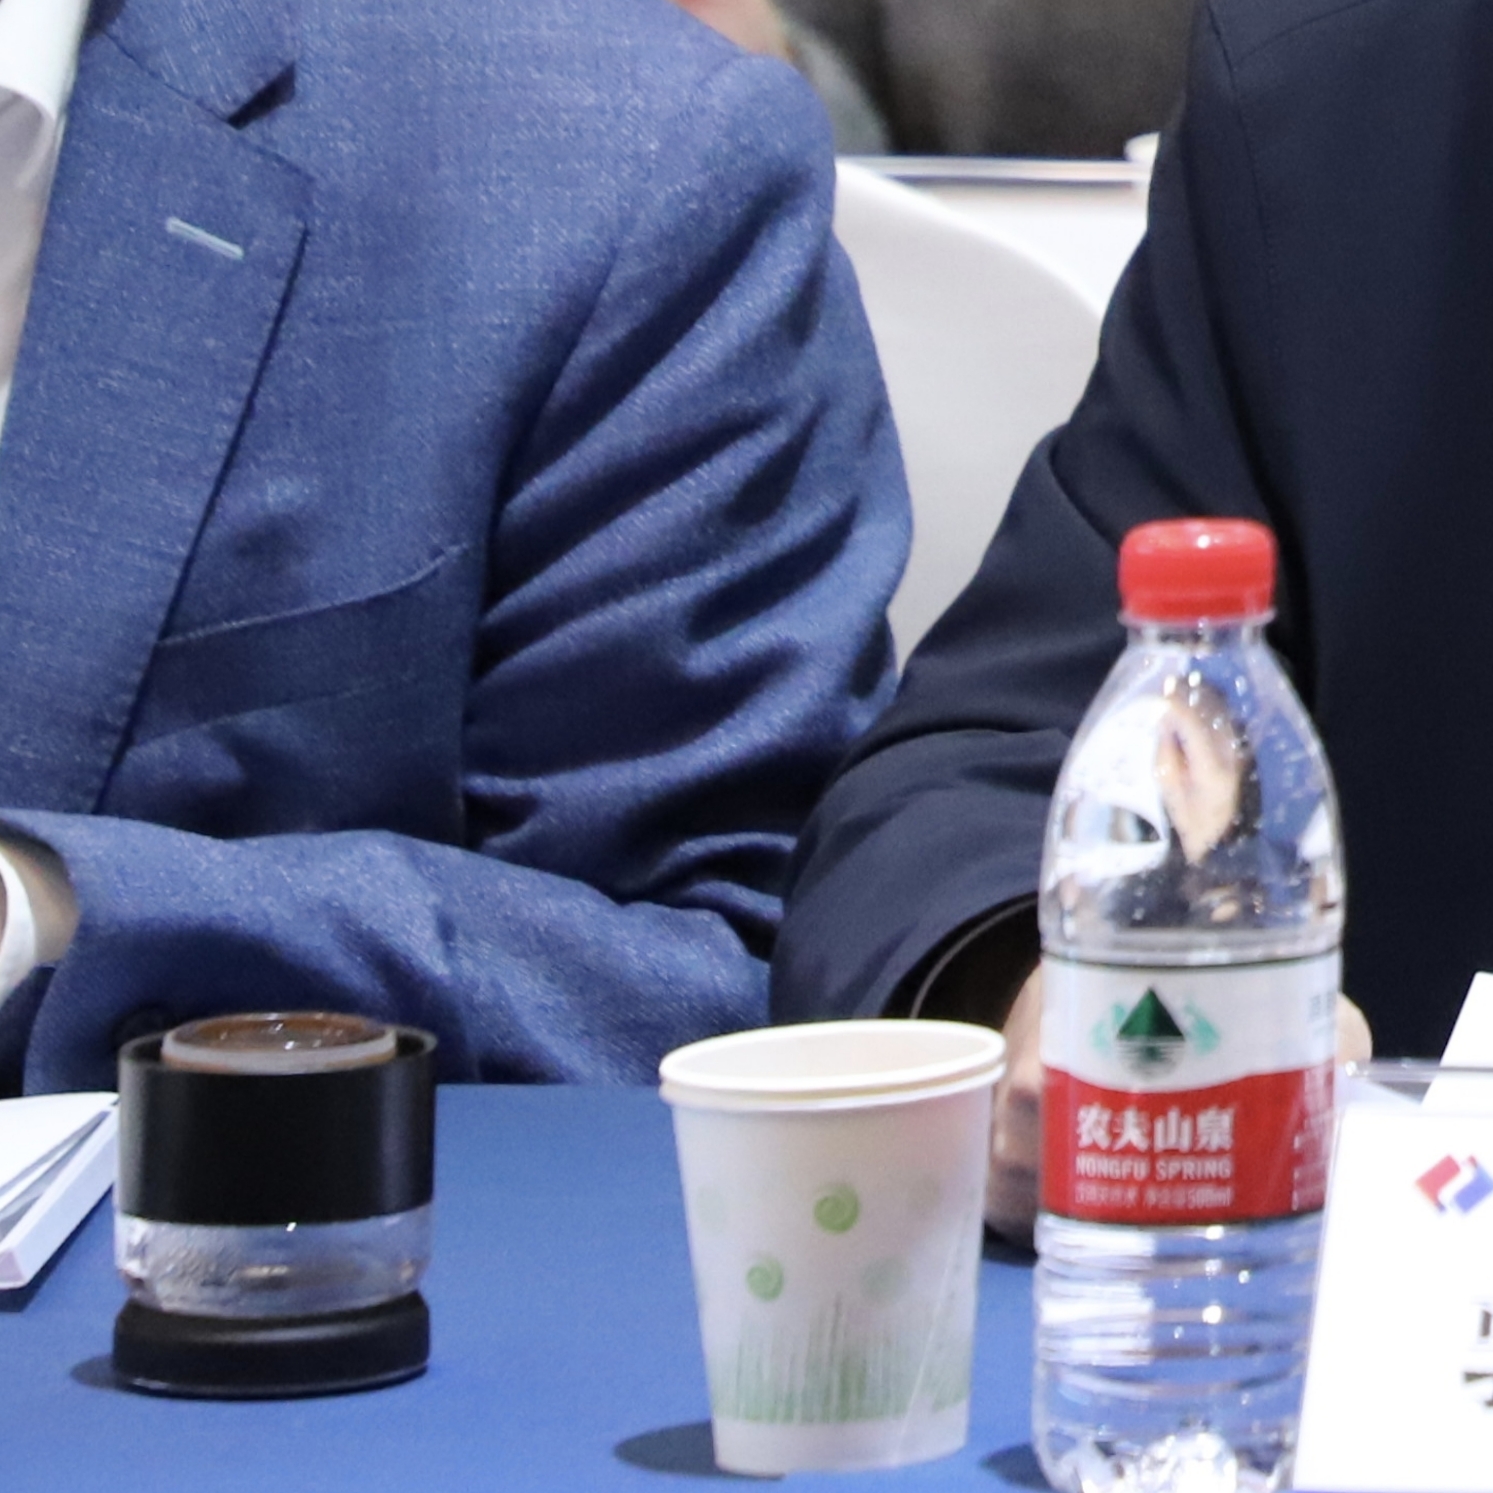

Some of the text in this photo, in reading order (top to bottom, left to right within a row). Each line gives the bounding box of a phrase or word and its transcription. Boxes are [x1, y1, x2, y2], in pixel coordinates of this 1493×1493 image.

[1077, 1103, 1235, 1152] 农夫山泉
[1076, 1154, 1233, 1181] NONGFU SPRING
